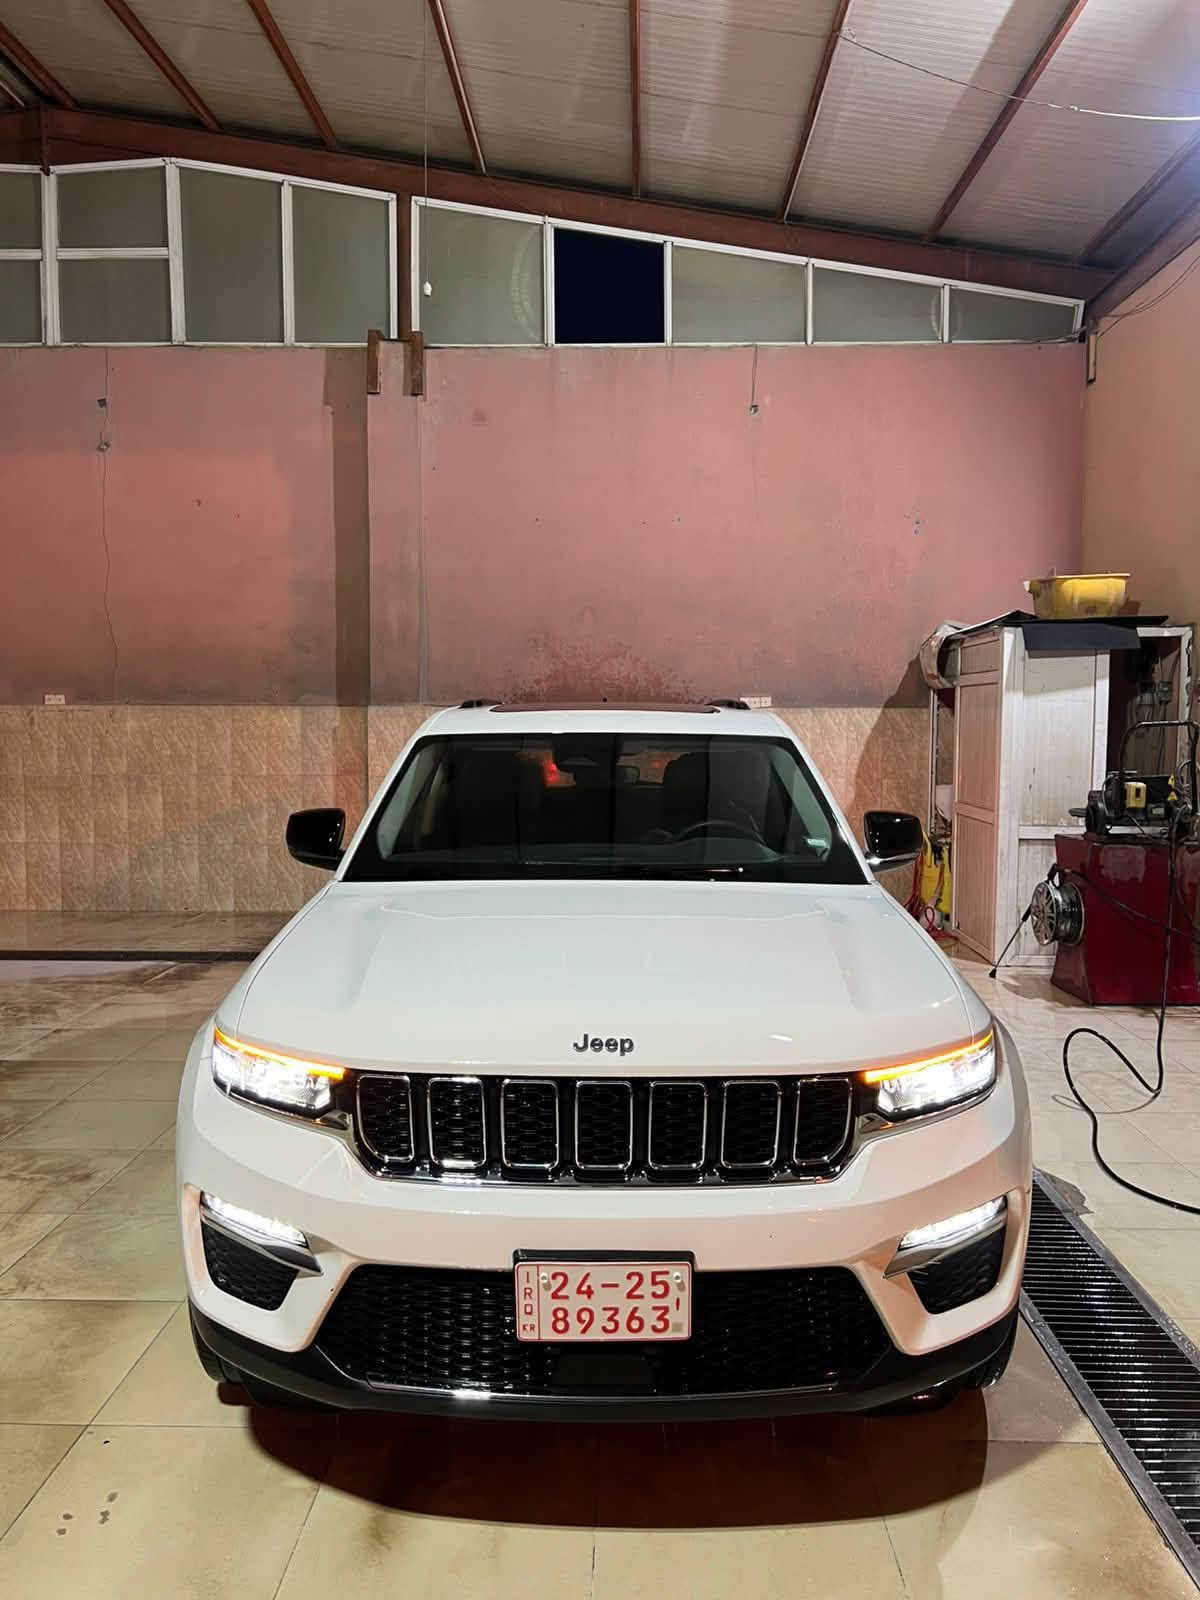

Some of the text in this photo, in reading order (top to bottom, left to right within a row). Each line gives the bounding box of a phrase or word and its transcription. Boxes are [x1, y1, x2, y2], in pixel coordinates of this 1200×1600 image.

[573, 1033, 634, 1056] Jeep
[551, 1270, 670, 1300] 24-25
[551, 1305, 670, 1334] 89363
